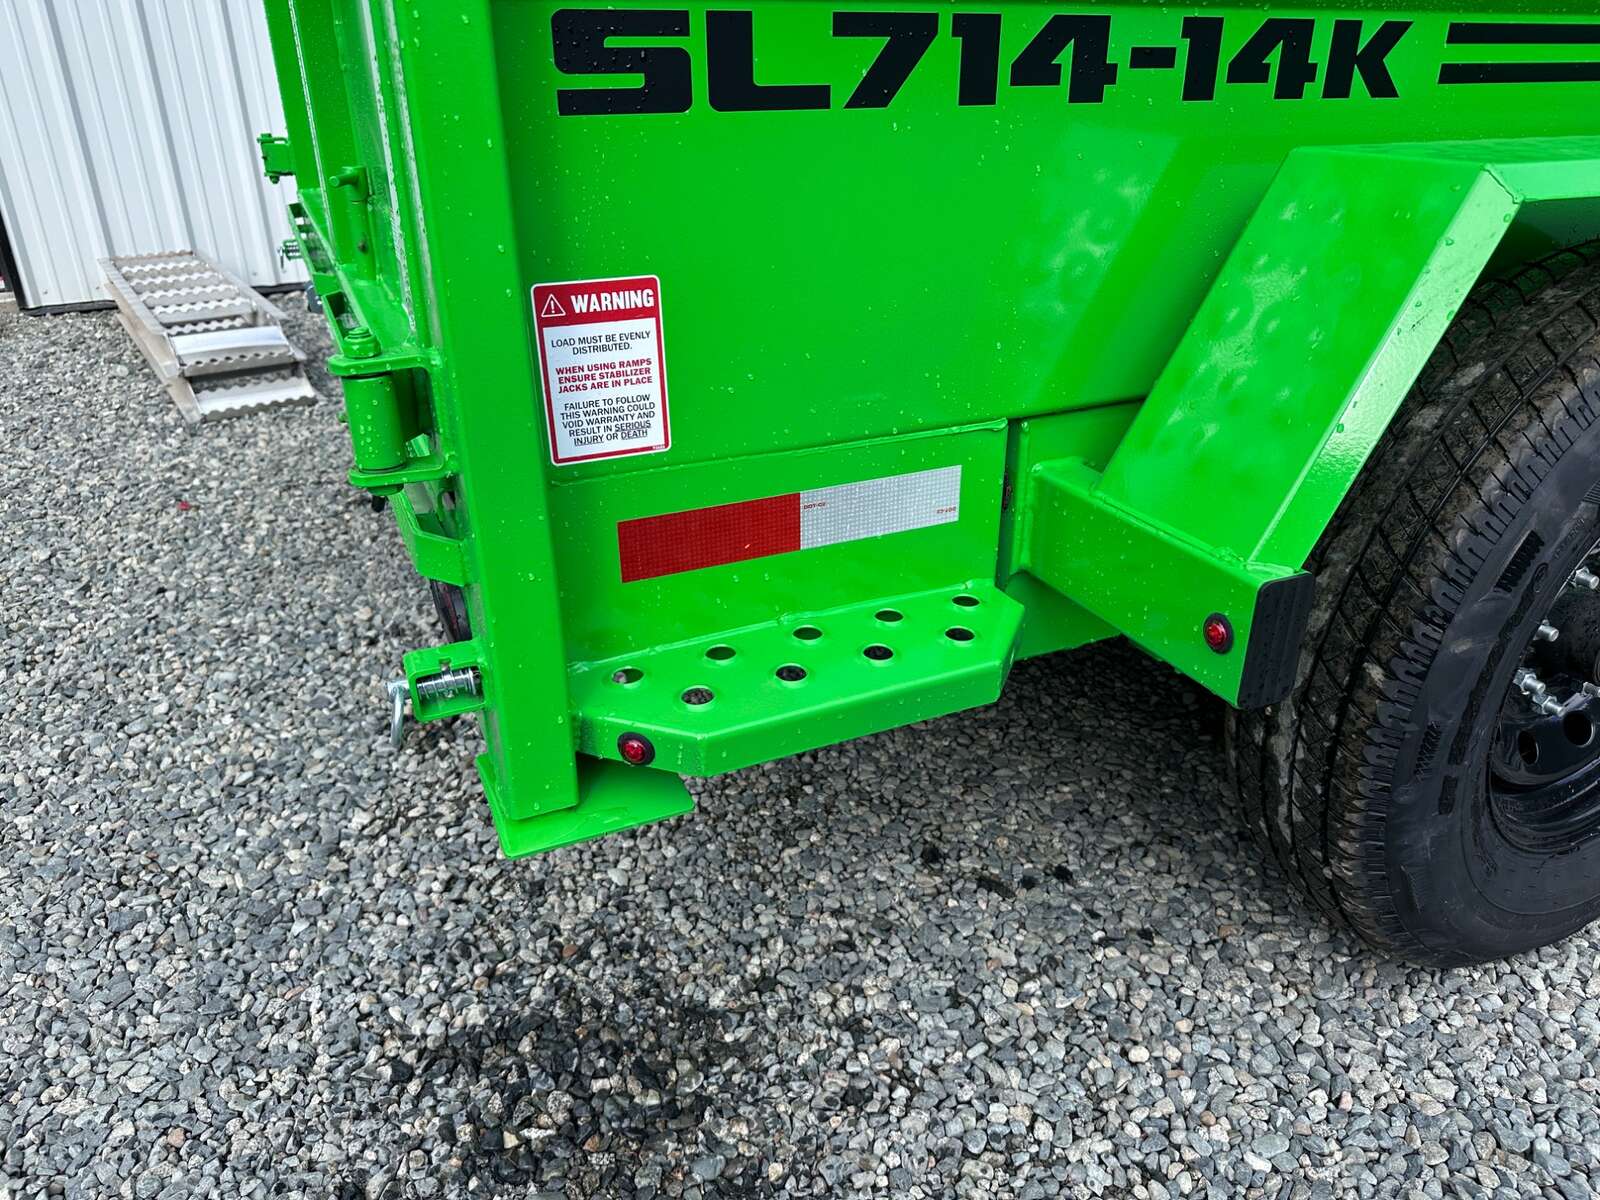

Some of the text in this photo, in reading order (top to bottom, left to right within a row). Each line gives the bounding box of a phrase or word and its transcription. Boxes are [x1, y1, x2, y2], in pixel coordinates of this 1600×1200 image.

[551, 9, 1413, 116] SL714-14K
[571, 289, 654, 313] WARNING
[551, 330, 650, 348] LOAD MUST BE EVENLY
[572, 342, 632, 355] DISTRIBUTED.
[556, 358, 652, 375] WHEN USING RAMPS
[558, 368, 651, 384] ENSURE STABILIZER
[558, 376, 652, 394] JACKS ARE IN PLACE
[560, 402, 656, 420] THIS WARNING COULD
[564, 400, 600, 411] FAILURE
[616, 394, 650, 404] FOLLOW
[562, 411, 655, 429] VOID WARRANTY AND
[568, 426, 601, 437] RESULT
[615, 420, 651, 431] SERIOUS
[574, 429, 648, 446] INJURY OR DEATH
